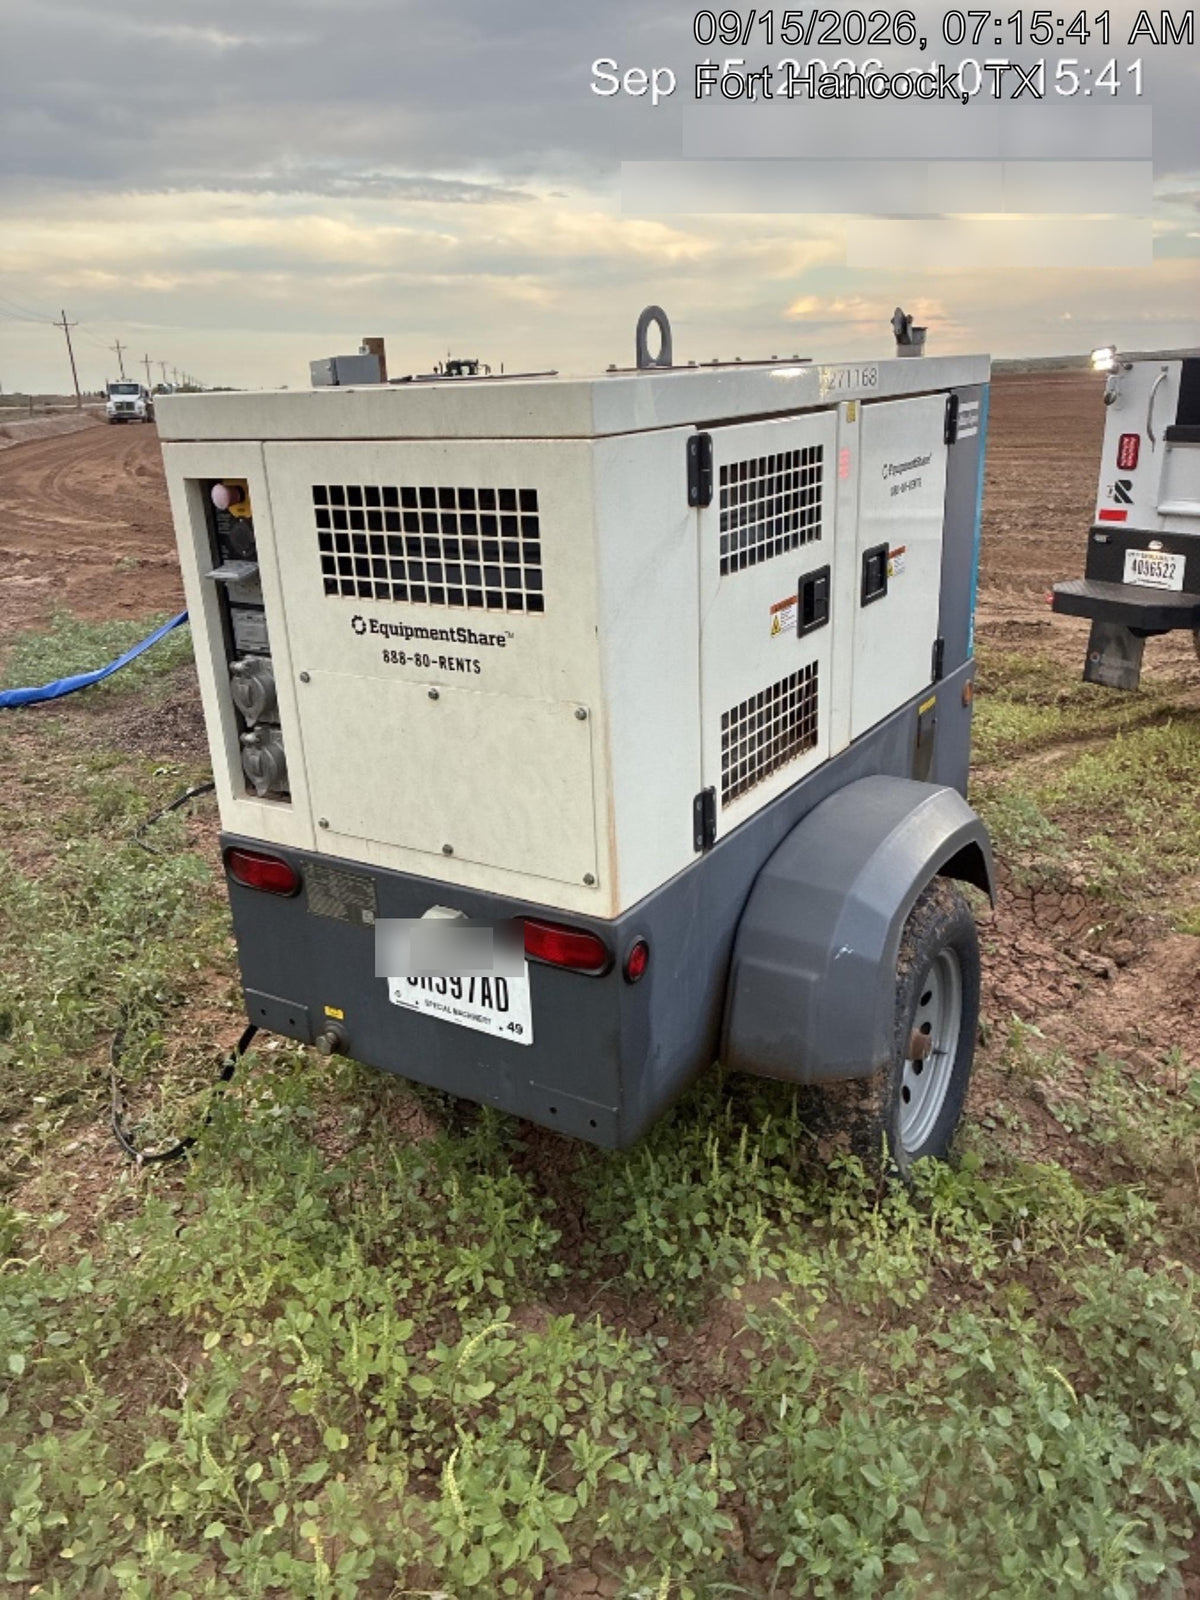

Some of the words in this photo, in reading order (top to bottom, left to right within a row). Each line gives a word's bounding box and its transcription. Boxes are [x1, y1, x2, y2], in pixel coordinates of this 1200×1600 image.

[369, 619, 507, 648] EquipmentShare
[383, 650, 482, 674] 888-80-RENTS
[507, 1021, 524, 1035] 49
